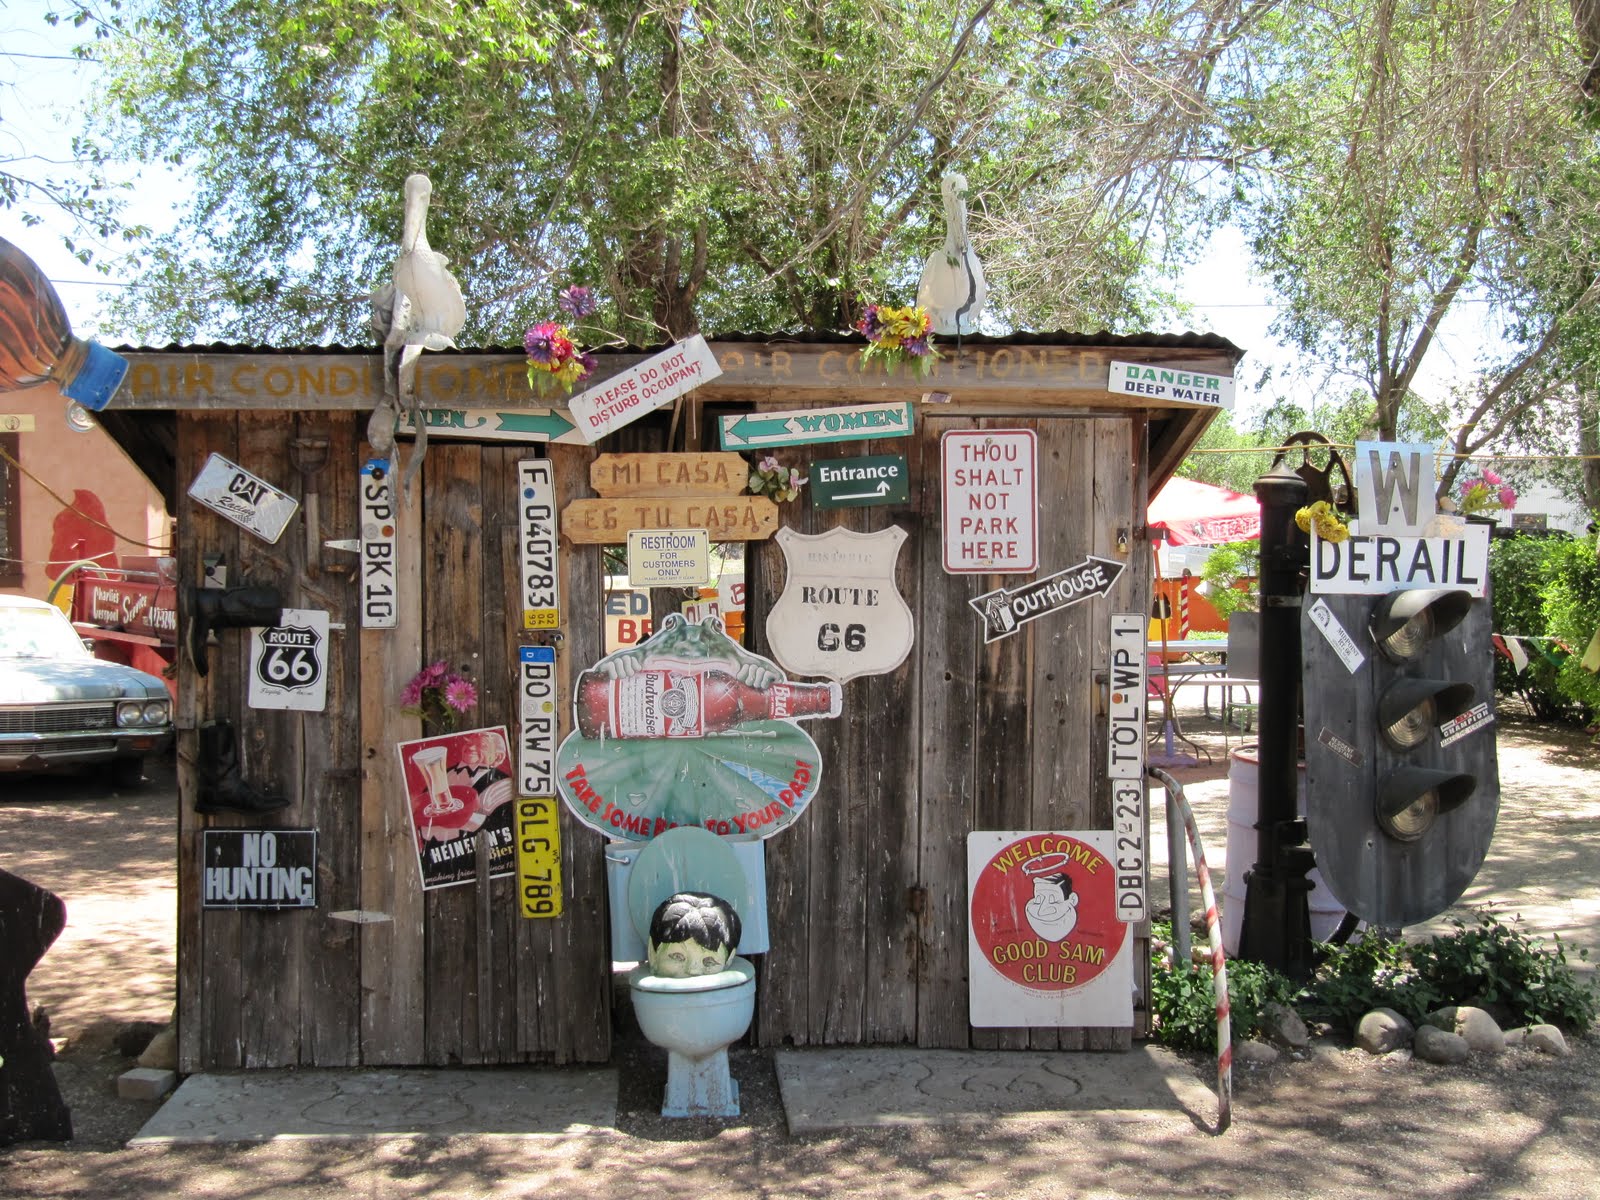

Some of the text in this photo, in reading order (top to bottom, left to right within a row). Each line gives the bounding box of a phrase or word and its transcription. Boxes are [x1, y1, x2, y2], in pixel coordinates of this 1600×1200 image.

[720, 351, 793, 377] AIR
[131, 362, 215, 397] AIR
[594, 352, 686, 408] PLEASE DO NOT
[1125, 366, 1220, 390] DANGER
[588, 361, 701, 427] DISTURB OCCUPANT
[1125, 381, 1220, 404] DEEP WATER
[407, 409, 486, 429] MEN
[794, 409, 903, 432] WOMEN
[960, 445, 1018, 462] THOU
[612, 460, 728, 484] MI CASA
[819, 465, 899, 483] Entrance
[954, 468, 1023, 486] SHALT
[228, 473, 269, 507] CAT
[1369, 450, 1420, 526] W
[216, 496, 256, 517] Racing
[969, 493, 1009, 510] NOT
[635, 506, 672, 528] TU
[687, 505, 758, 531] CASA
[961, 517, 1018, 534] PARK
[523, 468, 554, 607] F 040783
[641, 535, 696, 550] RESTROOM
[962, 541, 1018, 559] HERE
[365, 484, 393, 617] SP BK 10
[660, 552, 678, 560] FOR
[1316, 535, 1478, 585] DERAIL
[643, 560, 696, 568] CUSTOMERS
[658, 568, 681, 577] ONLY
[802, 586, 879, 607] ROUTE
[1013, 566, 1108, 616] OUTHOUSE
[269, 632, 311, 645] ROUTE
[817, 623, 866, 652] 66
[268, 648, 313, 681] 66
[645, 673, 659, 737] Budweiser
[525, 664, 551, 793] DO RW 75
[1443, 709, 1489, 737] CHAMPION
[565, 764, 602, 813] TAKE
[602, 803, 651, 837] SOME
[733, 802, 785, 835] YOUR
[778, 760, 814, 808] PAD!
[243, 832, 277, 868] NO
[489, 845, 515, 860] Bier
[993, 838, 1104, 875] WELCOME
[206, 866, 313, 901] HUNTING
[457, 867, 475, 880] frien
[490, 863, 505, 873] ince
[993, 940, 1105, 966] GOOD SAM
[1023, 963, 1077, 984] CLUB
